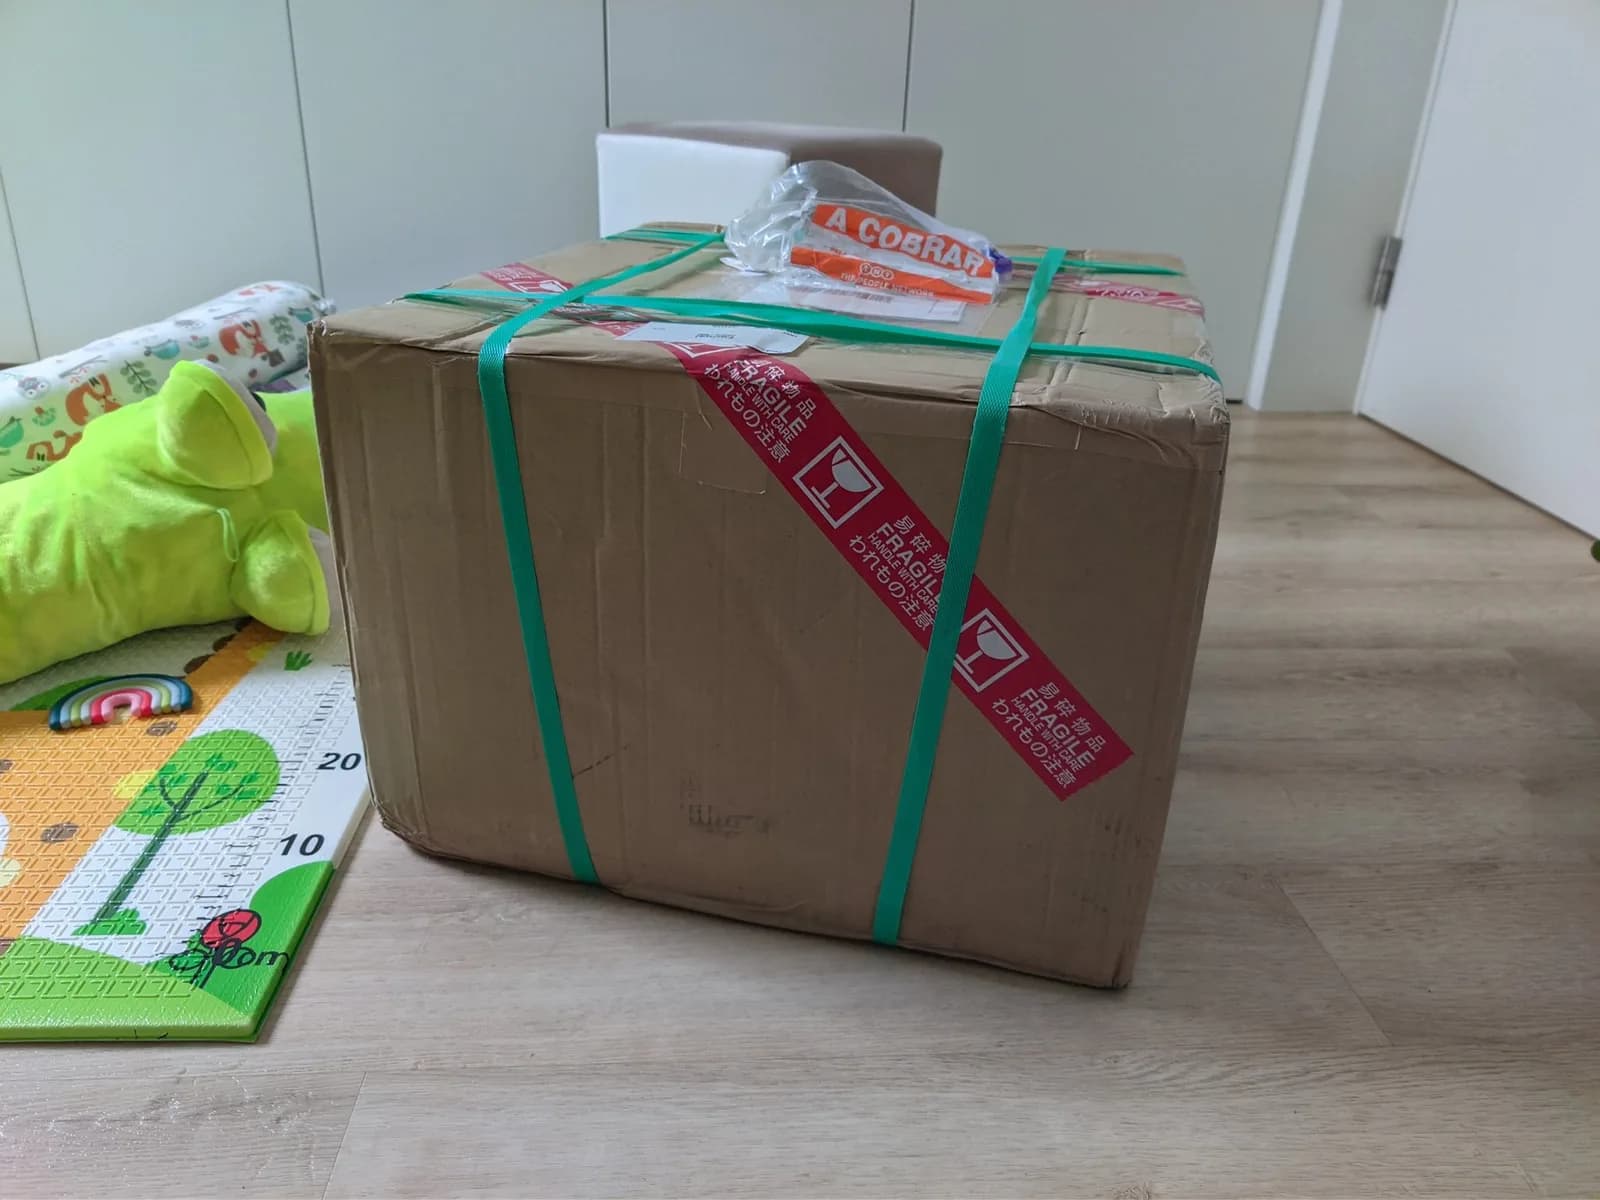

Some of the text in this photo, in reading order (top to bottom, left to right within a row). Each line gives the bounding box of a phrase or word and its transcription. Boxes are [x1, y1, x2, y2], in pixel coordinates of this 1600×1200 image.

[825, 207, 985, 275] A COBRAR
[704, 363, 791, 463] われもの注意
[720, 362, 795, 443] HANDLE WITH CARE
[734, 360, 807, 436] FRAGILE
[849, 535, 935, 631] われもの注意
[867, 532, 938, 613] HANDLE WITH CARE
[877, 522, 941, 603] FRAGIL
[894, 515, 947, 573] 易碎物
[317, 752, 362, 770] 20
[992, 698, 1077, 788] われもの注意
[1011, 697, 1082, 773] HANDLE WITH CARE
[1020, 688, 1095, 767] FRAGILE
[279, 834, 324, 856] 10
